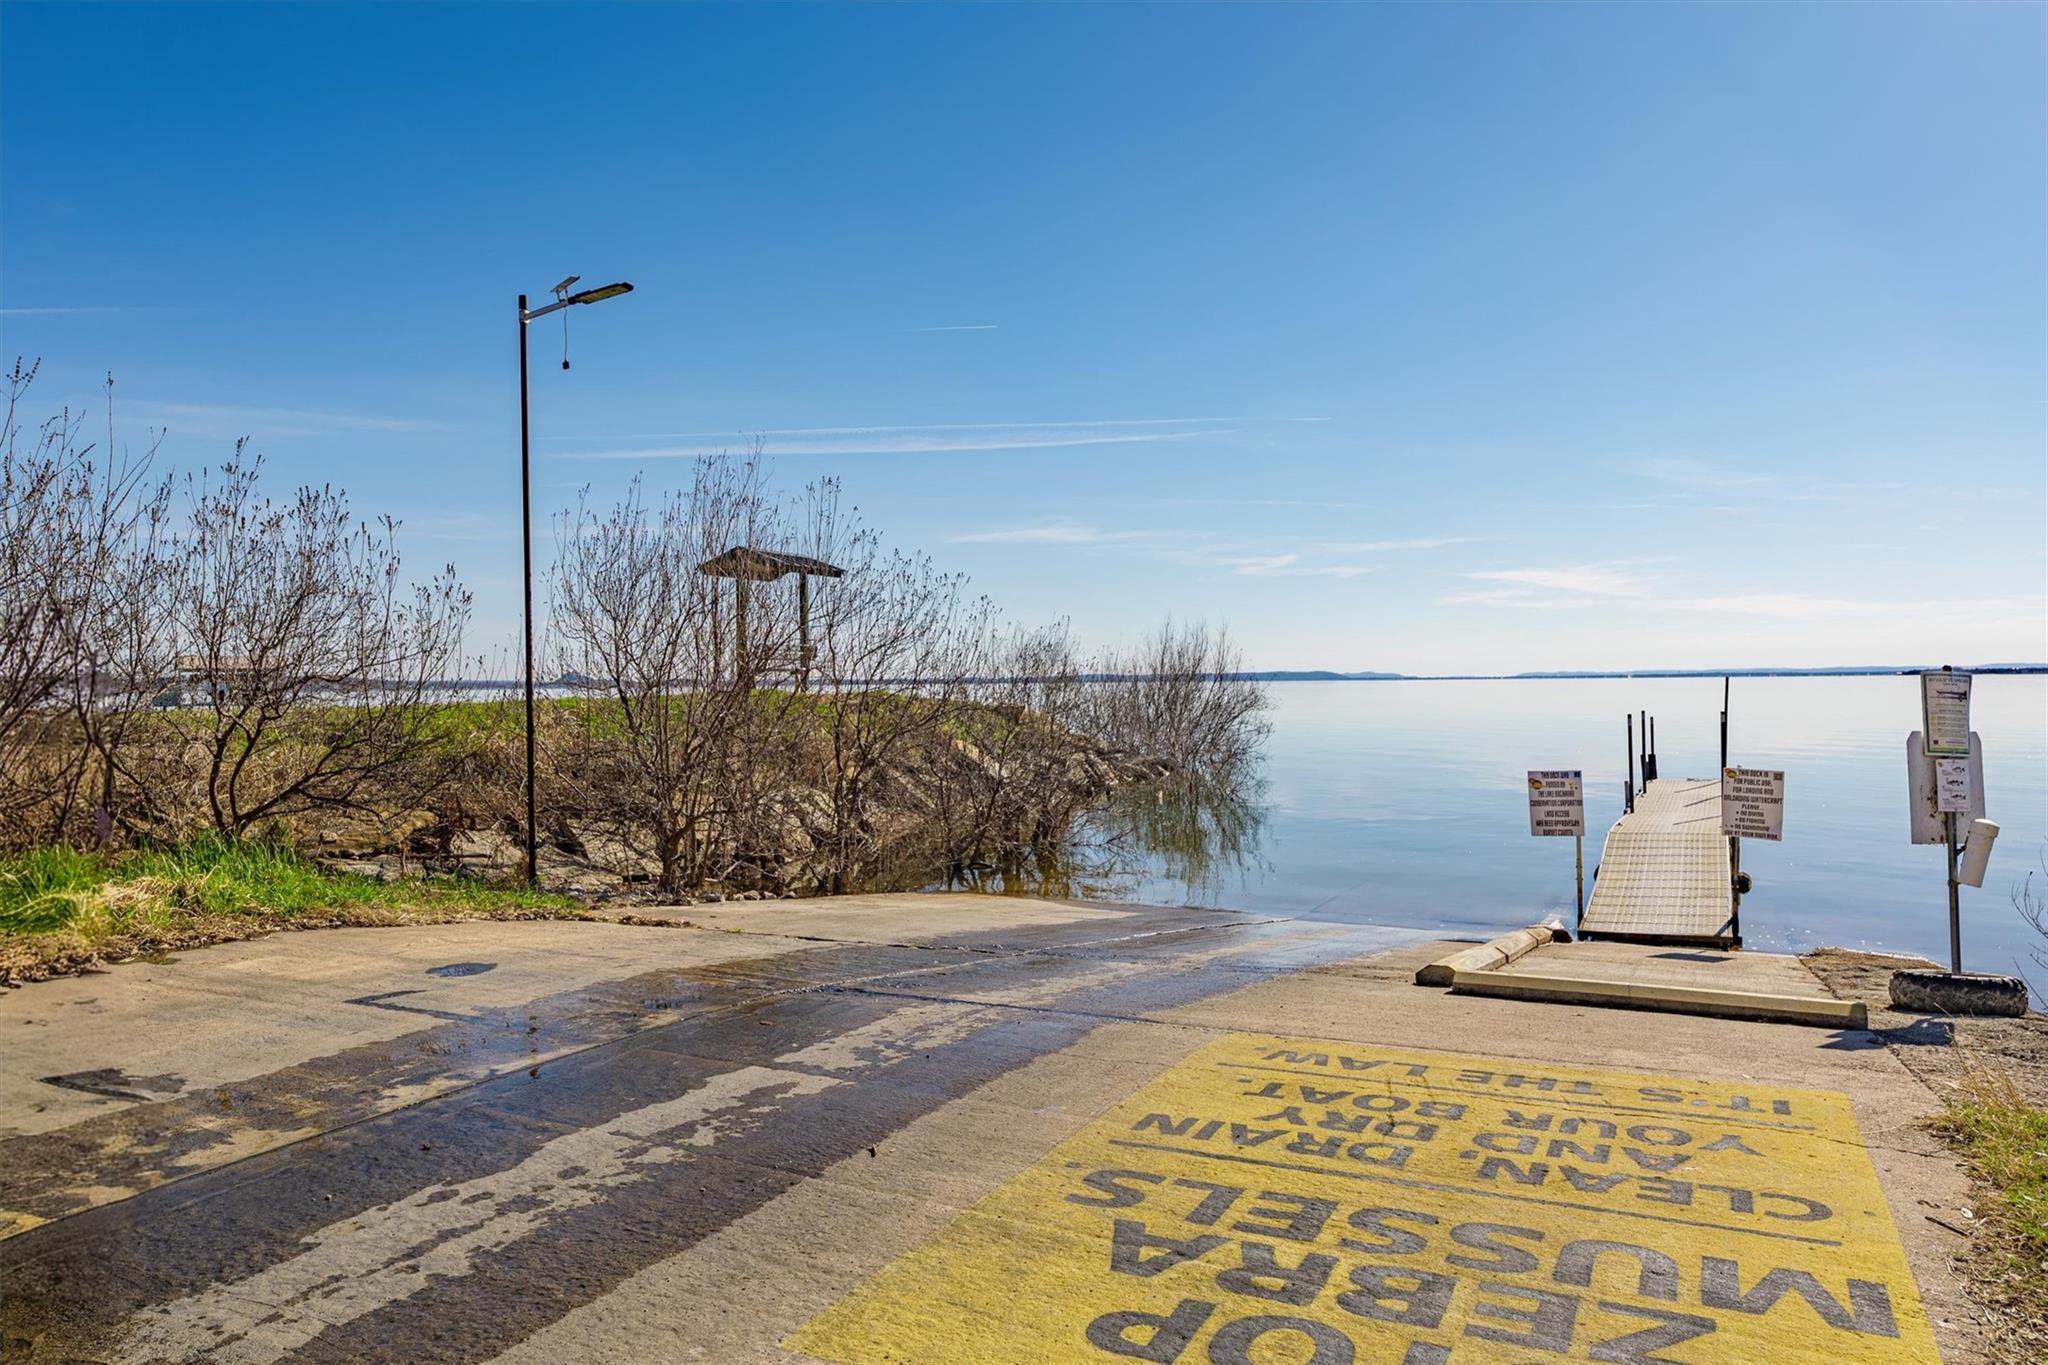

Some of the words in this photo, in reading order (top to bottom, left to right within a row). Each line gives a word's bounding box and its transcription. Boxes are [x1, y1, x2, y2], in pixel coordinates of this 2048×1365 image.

[1550, 771, 1559, 779] DOCK
[1744, 778, 1760, 786] PUBLIC
[1724, 794, 1750, 802] UNLOADING
[1751, 796, 1783, 804] WATERCRAFT
[1764, 788, 1774, 796] AND
[1457, 1068, 1603, 1095] THE
[1638, 1087, 1792, 1115] IT'S
[1253, 1106, 1440, 1142] DRY
[1502, 1110, 1766, 1157] YOUR
[1131, 1113, 1414, 1167] DRAIN
[1472, 1132, 1694, 1171] AND
[1111, 1218, 1717, 1365] ZEBRA
